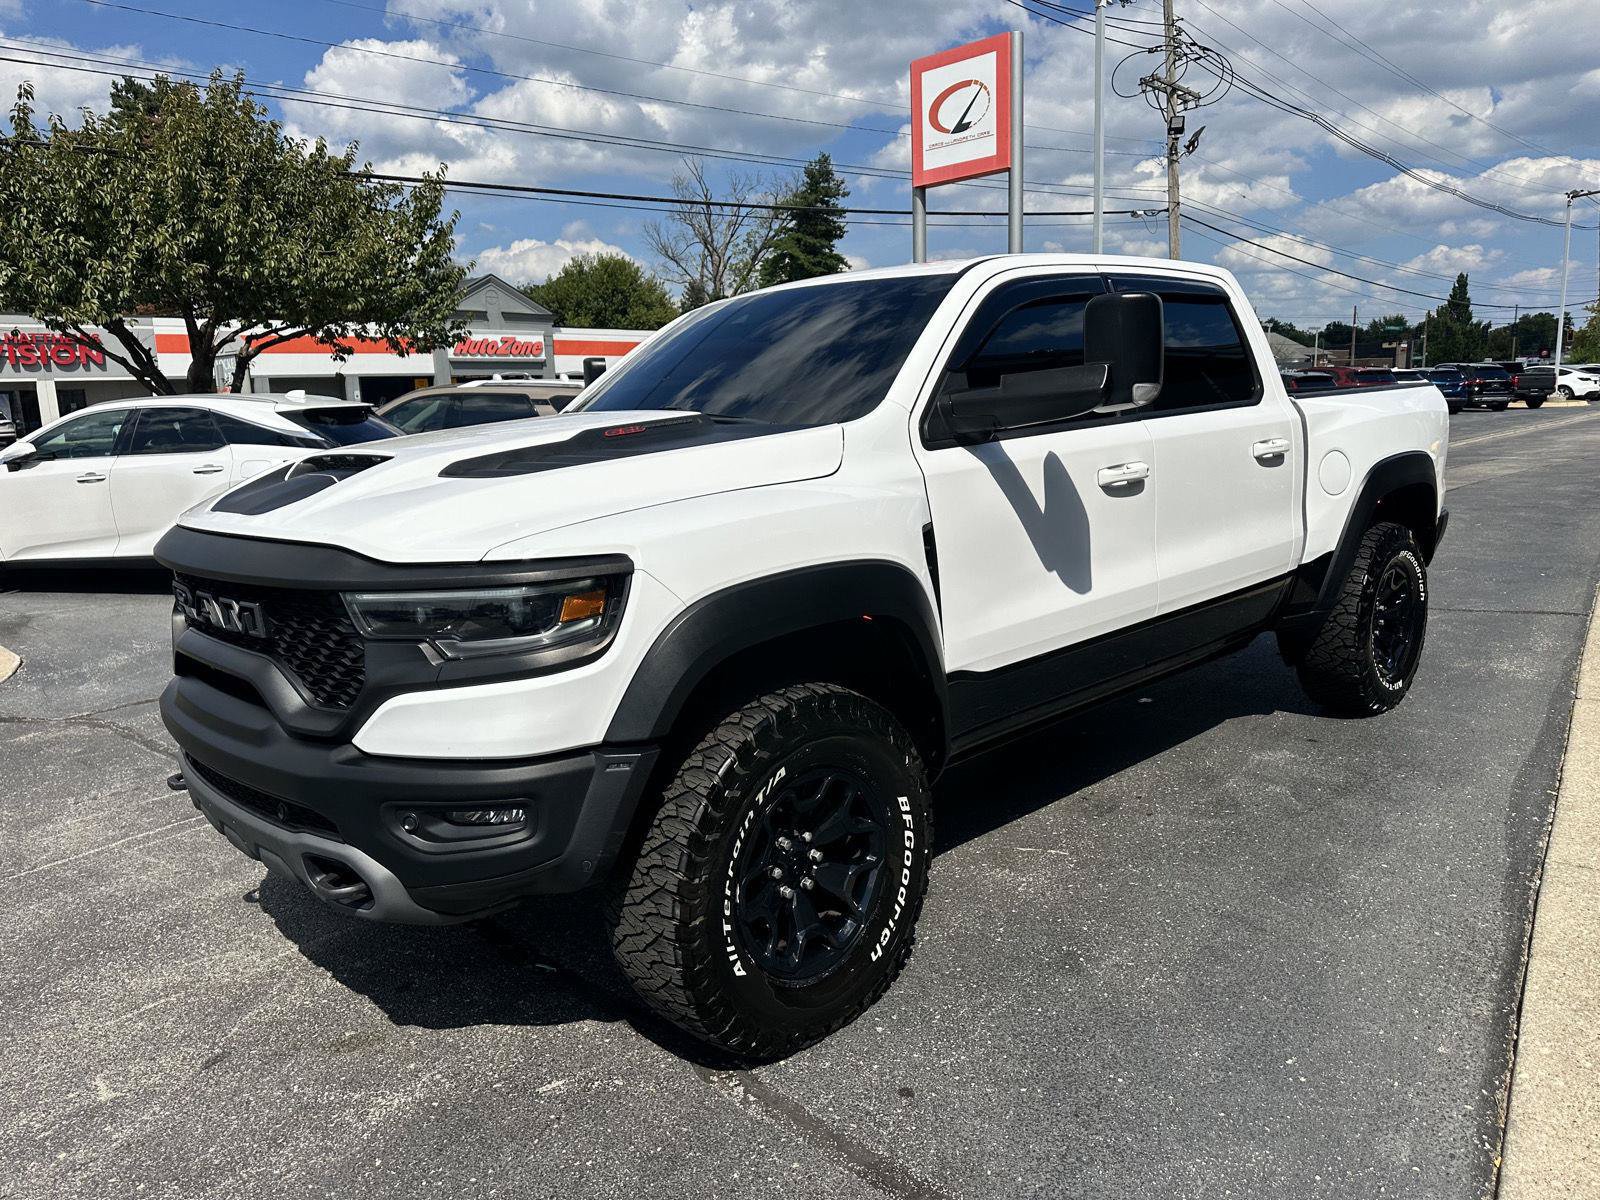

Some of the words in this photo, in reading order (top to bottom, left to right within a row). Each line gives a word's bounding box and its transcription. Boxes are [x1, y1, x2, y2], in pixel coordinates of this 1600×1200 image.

[0, 345, 103, 365] ISION
[453, 336, 543, 355] AutoZone
[1399, 550, 1425, 601] BFGoodrich
[723, 810, 753, 976] All-Terrain
[755, 766, 786, 804] T/A
[871, 796, 915, 962] BFGoodrich
